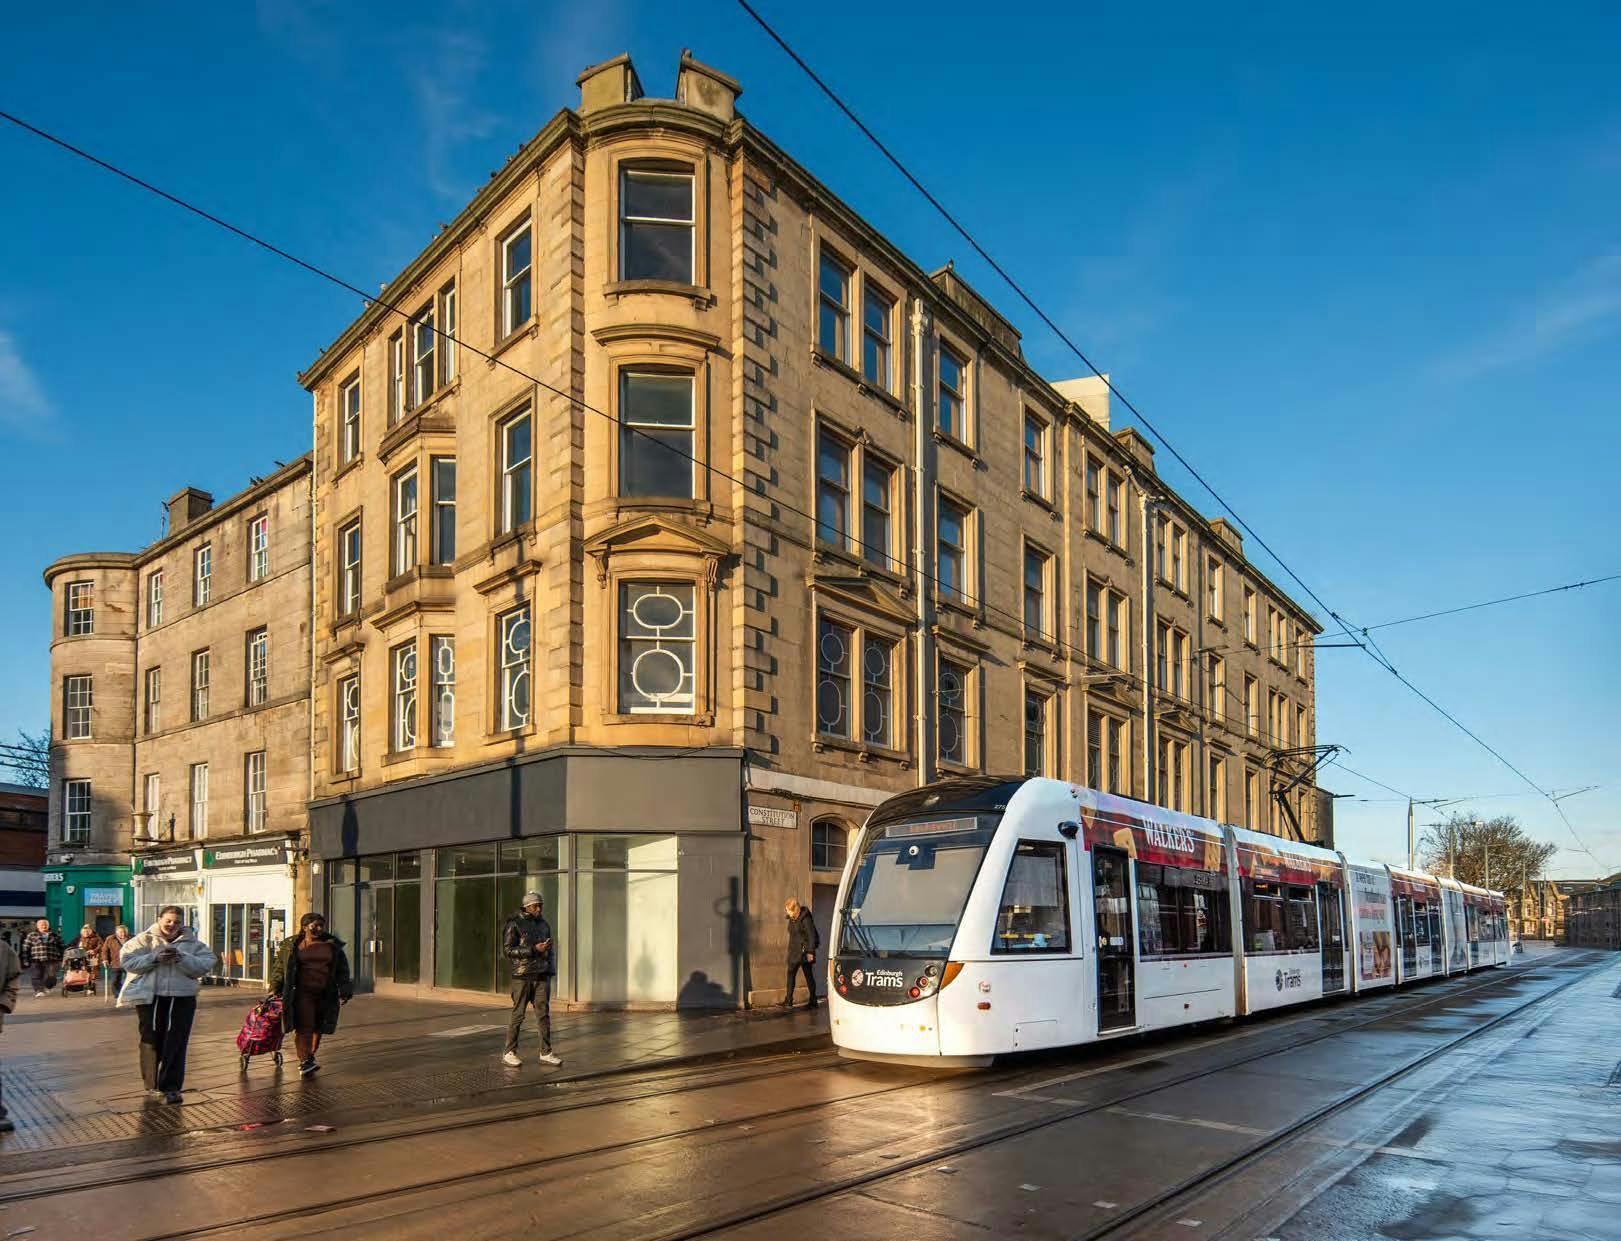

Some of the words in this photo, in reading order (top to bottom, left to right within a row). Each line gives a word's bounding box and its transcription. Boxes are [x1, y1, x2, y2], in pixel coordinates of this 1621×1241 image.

[750, 808, 794, 819] CONSTITUTION
[762, 817, 784, 825] STREET
[865, 972, 903, 988] Trams
[1284, 972, 1301, 989] Trams
